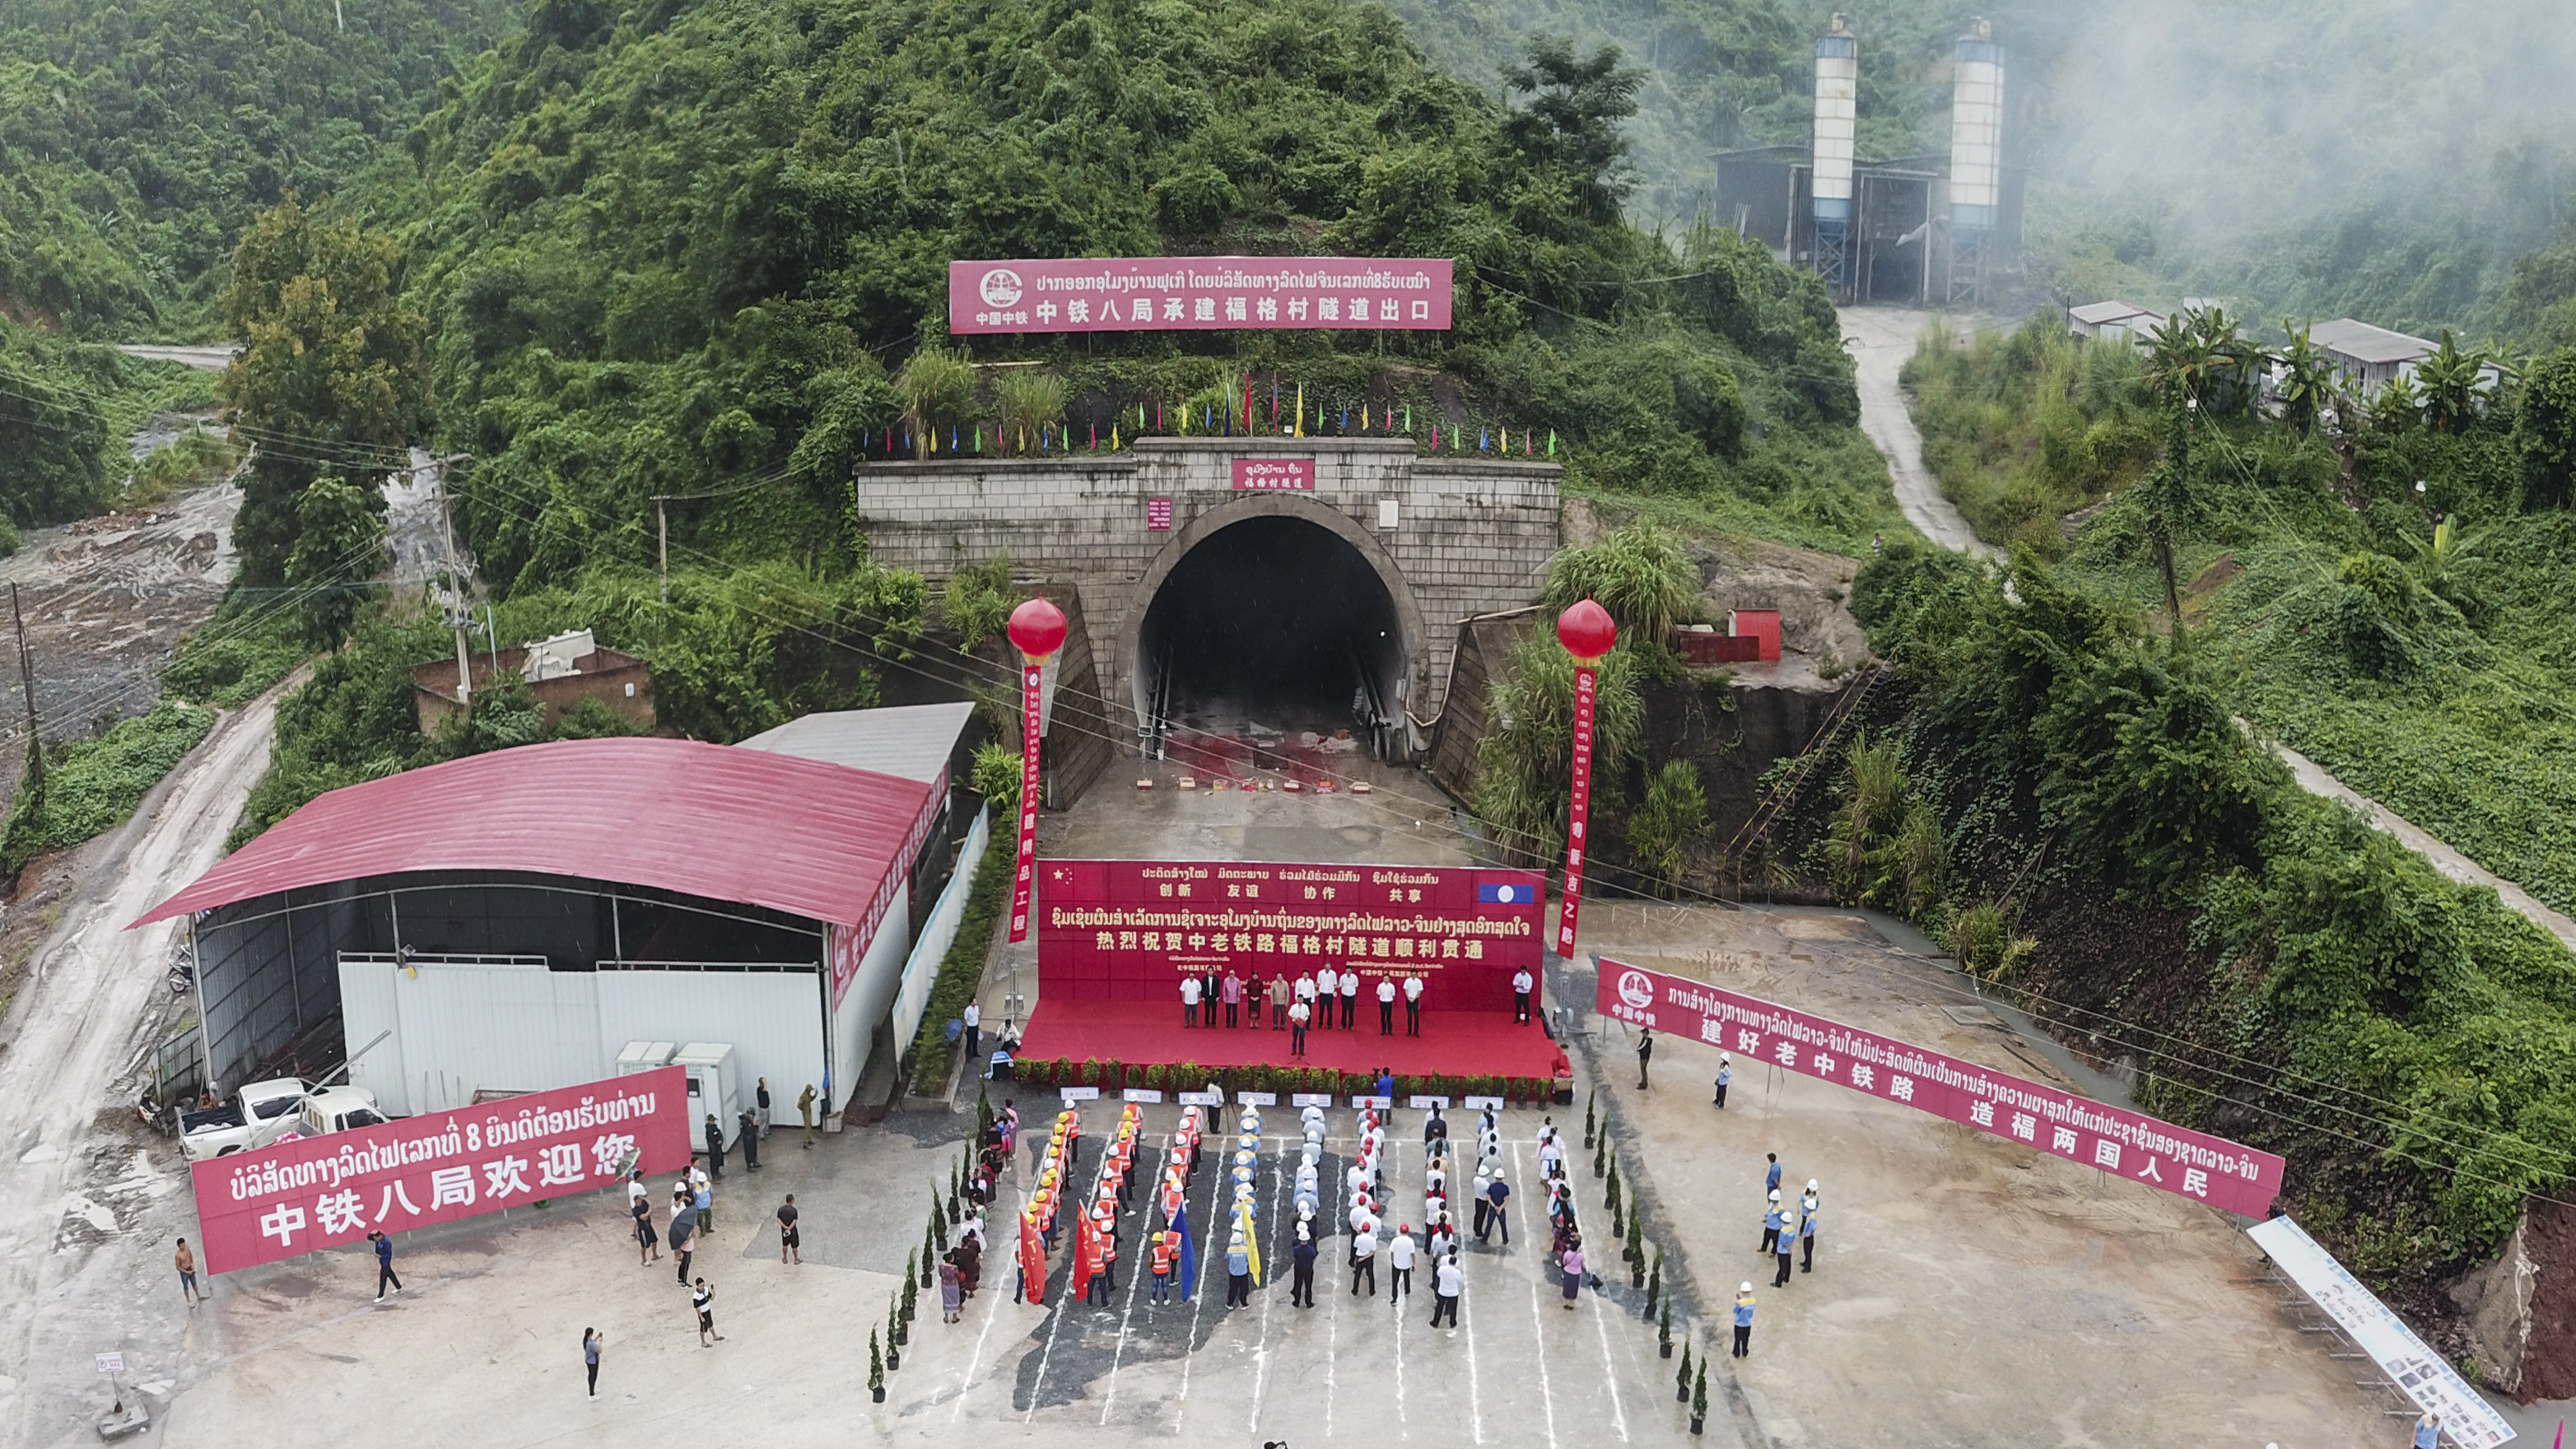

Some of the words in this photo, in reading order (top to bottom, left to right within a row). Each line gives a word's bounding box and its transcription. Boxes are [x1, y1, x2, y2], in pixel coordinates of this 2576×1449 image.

[976, 310, 1028, 326] 中国中铁
[1036, 297, 1428, 325] 中铁八局承建福格村隧道出口
[1159, 883, 1191, 897] 创新
[1227, 884, 1260, 898] 友谊
[1303, 886, 1336, 901] 协作
[1389, 888, 1422, 903] 共享
[1096, 931, 1483, 959] 热烈祝贺中老铁路福格村隧道顺利贯通
[1612, 1003, 1656, 1027] 中国中铁
[1701, 1018, 1914, 1102] 建好老中铁路
[1970, 1099, 2208, 1198] 造福两国人民
[466, 1122, 482, 1152] 8
[260, 1132, 636, 1247] 中铁八局欢迎您
